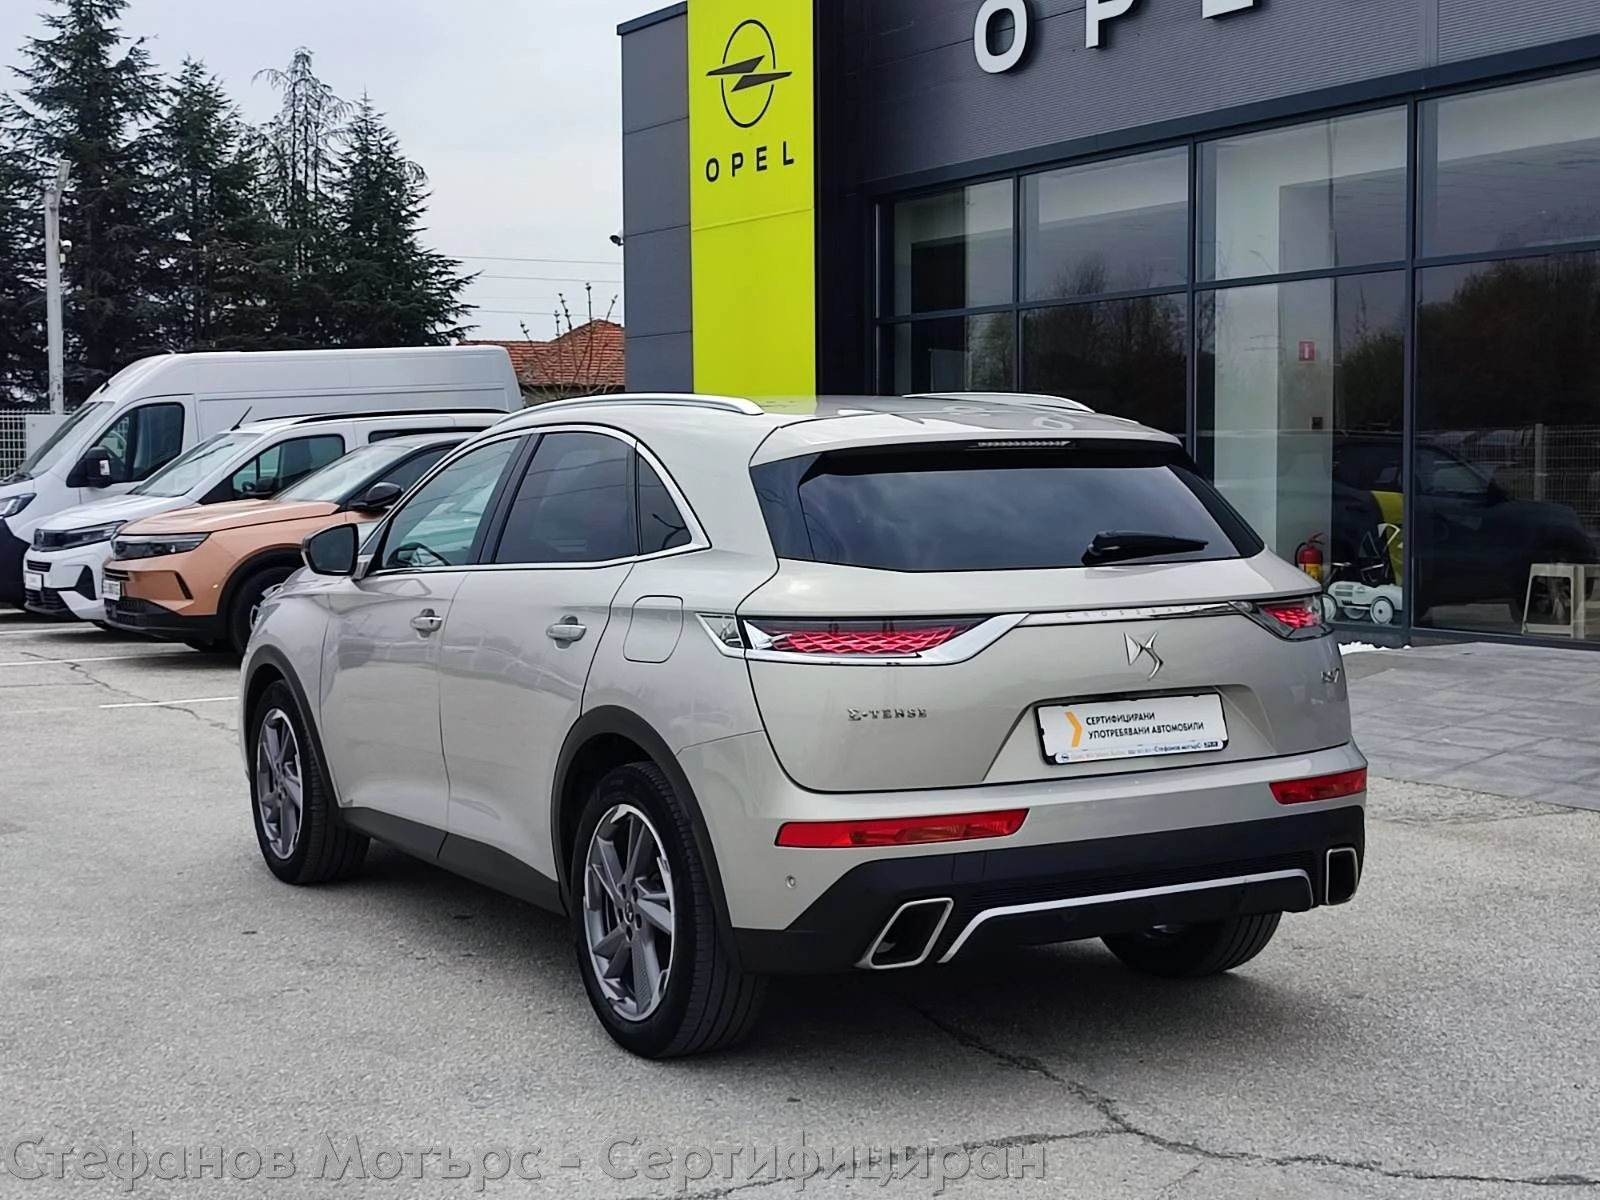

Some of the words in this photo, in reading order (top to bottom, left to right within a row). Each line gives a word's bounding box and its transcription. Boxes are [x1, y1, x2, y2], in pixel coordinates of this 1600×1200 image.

[973, 0, 1254, 74] OP
[705, 141, 794, 183] OPEL
[1086, 712, 1156, 726] СЕРТИФИЦИРАНИ
[1088, 727, 1150, 740] УПОТРЕБЯВАНИ
[1152, 722, 1204, 734] АВТОМОБИЛИ
